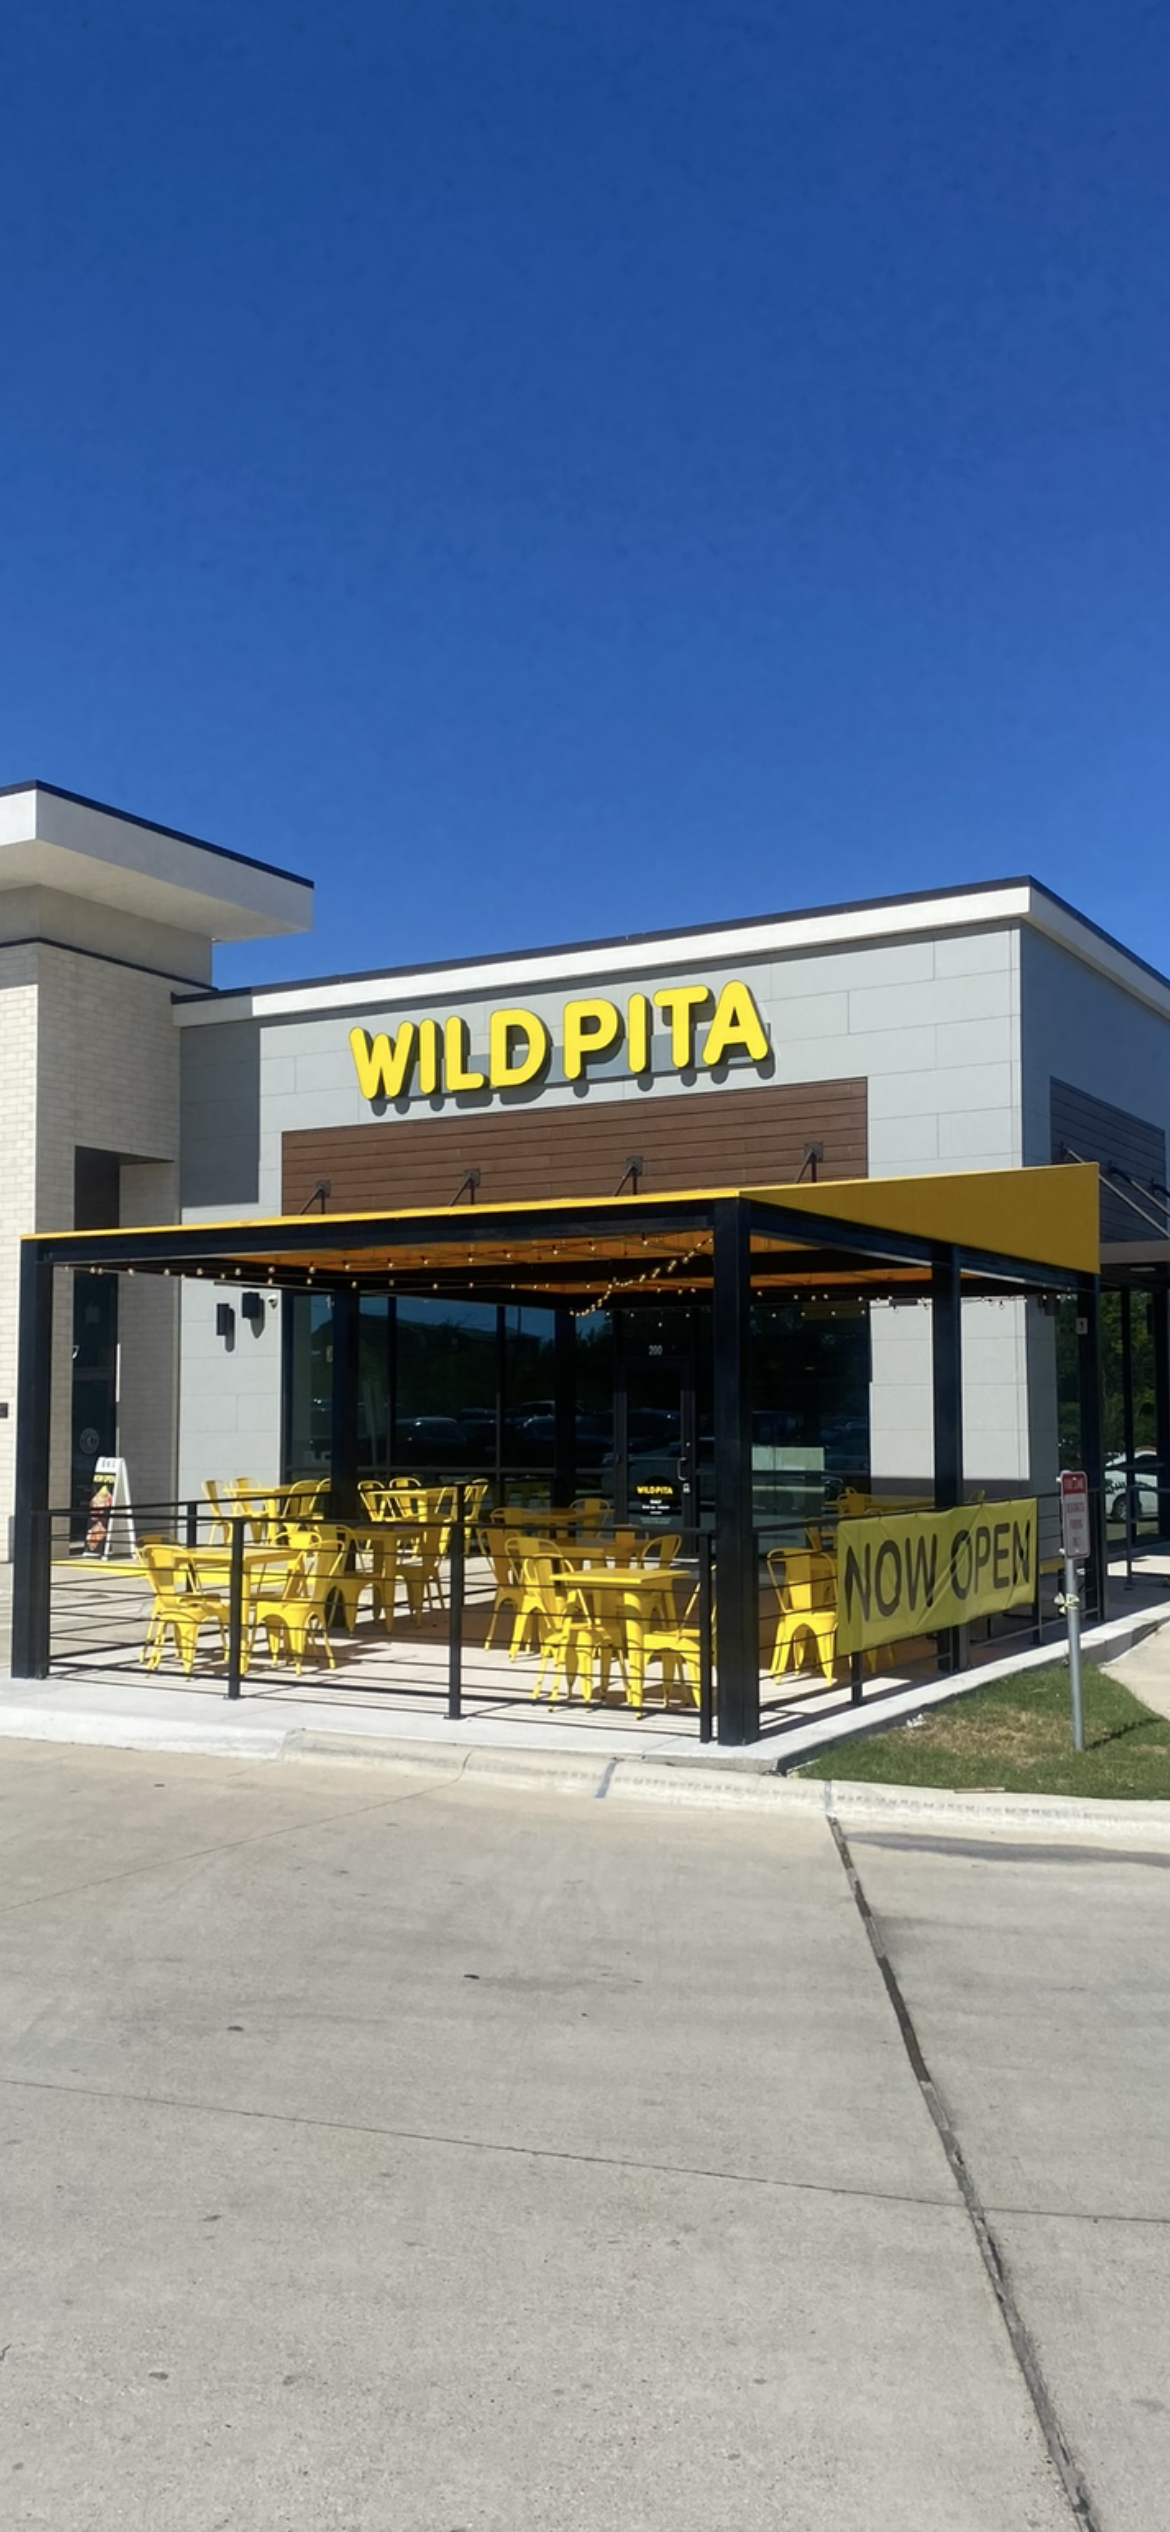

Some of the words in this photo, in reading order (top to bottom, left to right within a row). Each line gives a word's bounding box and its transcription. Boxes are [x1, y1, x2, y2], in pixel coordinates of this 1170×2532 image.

[349, 1008, 548, 1099] WILD
[563, 980, 770, 1080] PITA
[844, 1533, 938, 1624] NOW
[951, 1519, 1031, 1600] OPEN
